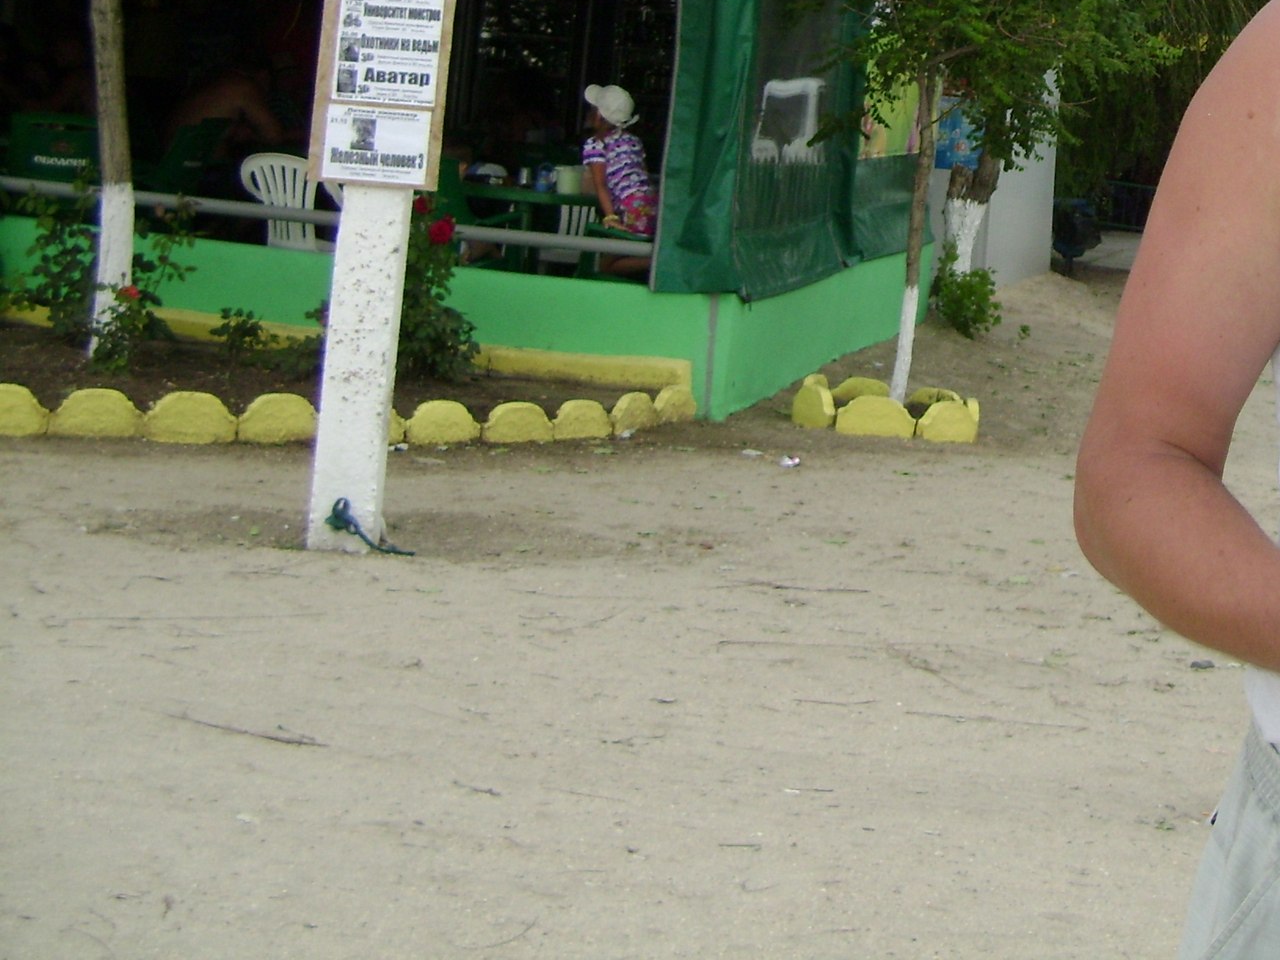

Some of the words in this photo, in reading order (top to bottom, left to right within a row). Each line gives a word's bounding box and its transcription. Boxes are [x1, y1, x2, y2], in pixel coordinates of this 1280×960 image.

[363, 67, 431, 87] Аватар
[330, 146, 379, 166] Железный
[380, 153, 417, 169] человек
[418, 153, 424, 169] 3
